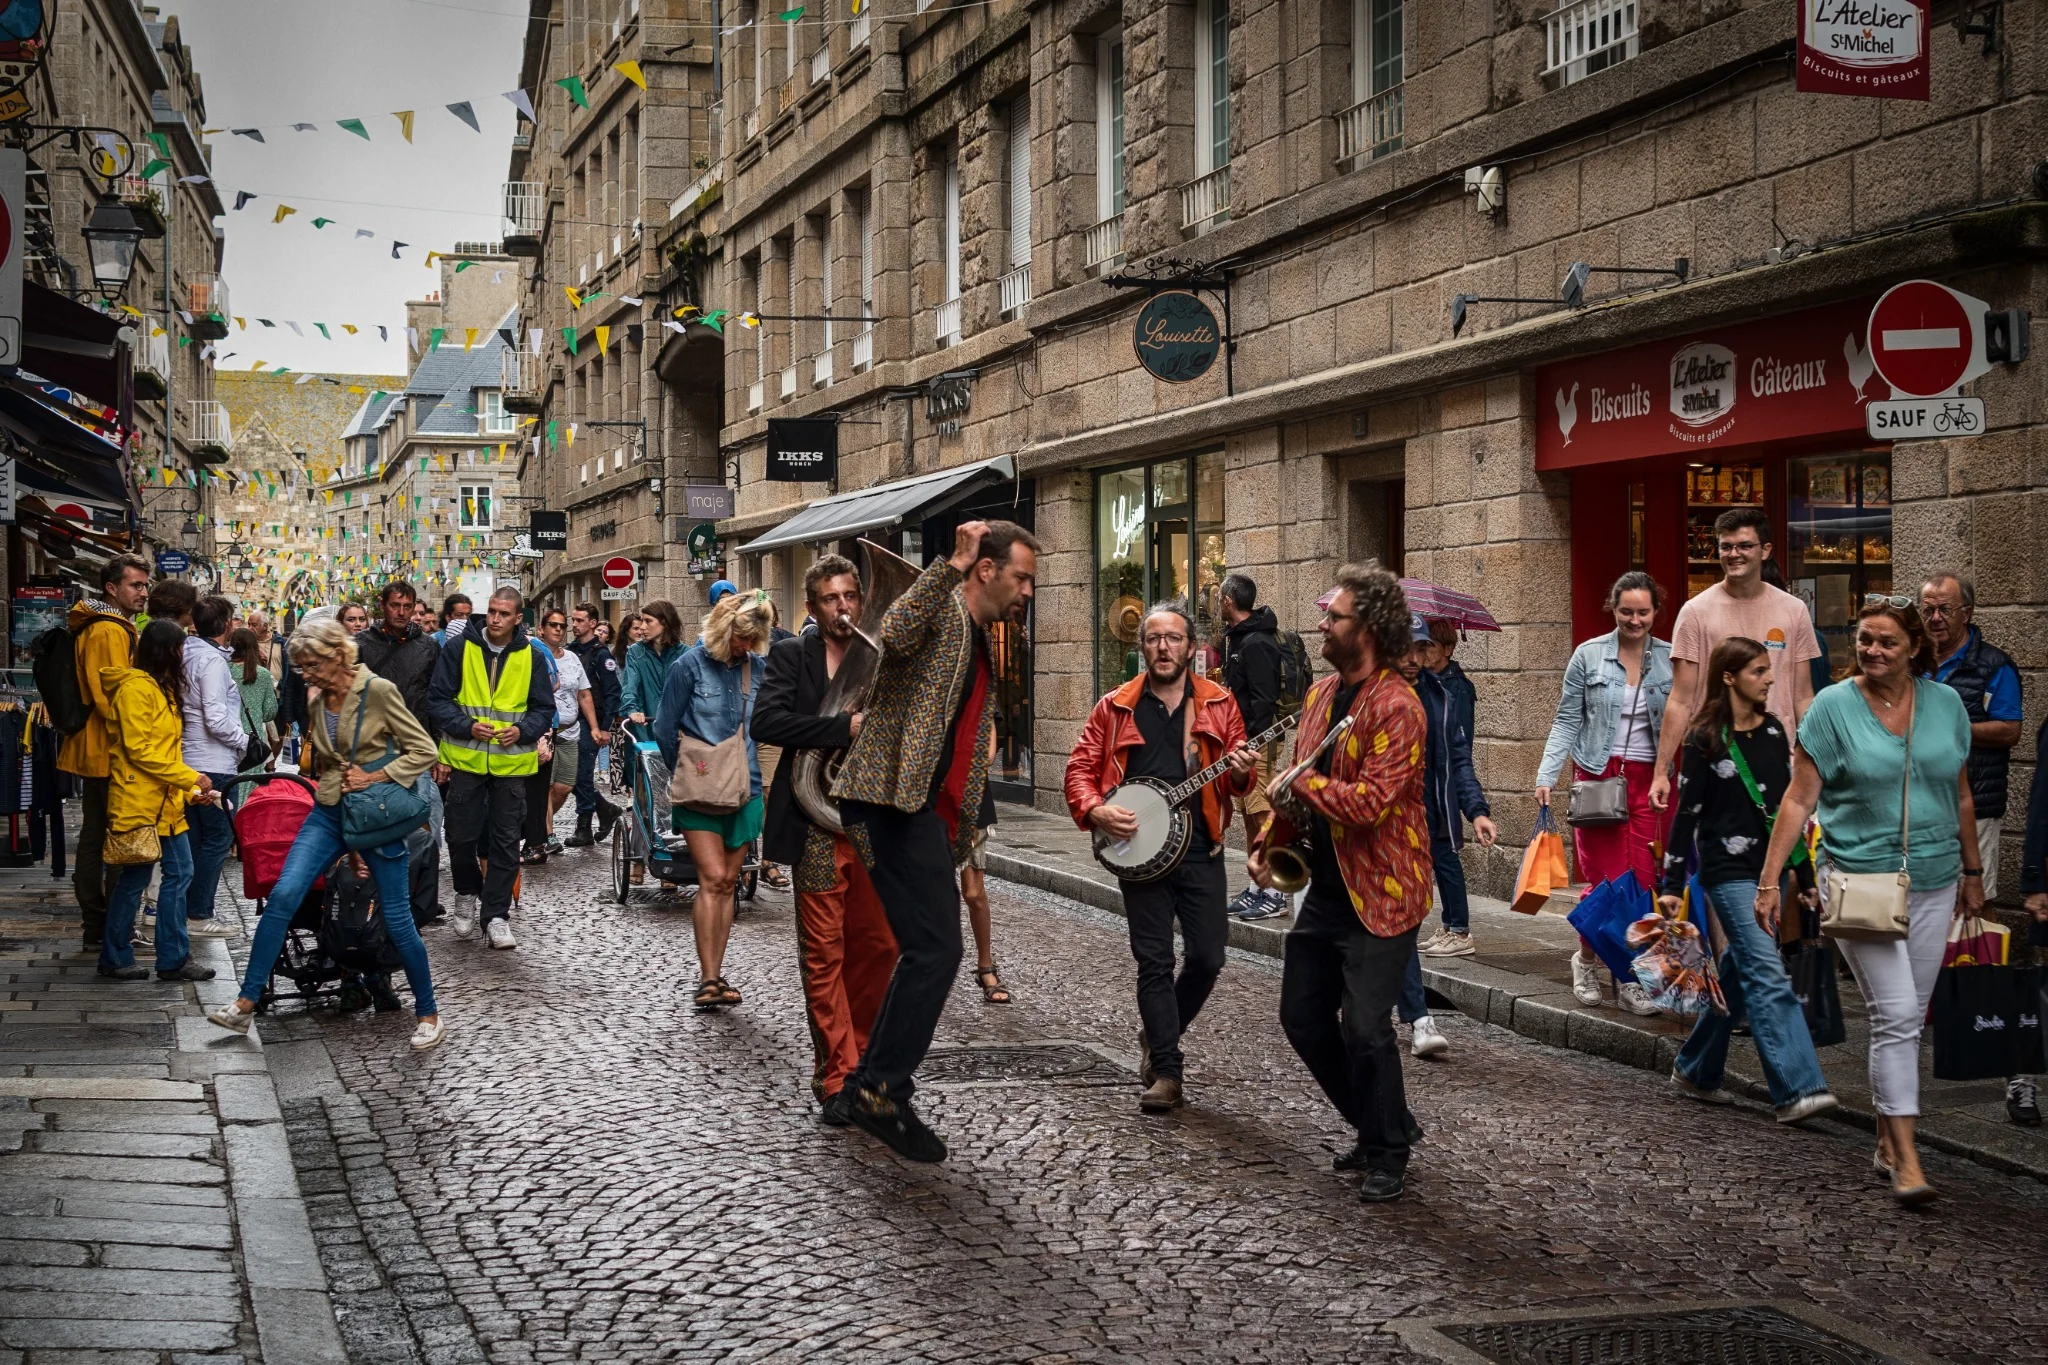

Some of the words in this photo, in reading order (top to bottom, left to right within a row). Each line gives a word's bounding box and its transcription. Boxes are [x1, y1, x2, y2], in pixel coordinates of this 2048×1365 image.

[1815, 0, 1913, 29] L'Atelier
[1802, 56, 1851, 82] Biscuits
[1855, 74, 1868, 84] et
[1872, 67, 1921, 87] gâteaux
[1140, 316, 1215, 350] Louisette
[1673, 354, 1732, 390] L'Atelier
[1750, 355, 1827, 398] Gâteaux
[1590, 382, 1651, 424] Biscuits
[1668, 423, 1696, 443] Biscuits
[1697, 434, 1705, 442] et
[1707, 417, 1736, 443] gâteaux
[1876, 409, 1927, 429] SAUF
[777, 451, 824, 462] IKKS
[691, 493, 724, 514] maje
[537, 531, 566, 539] IKKS
